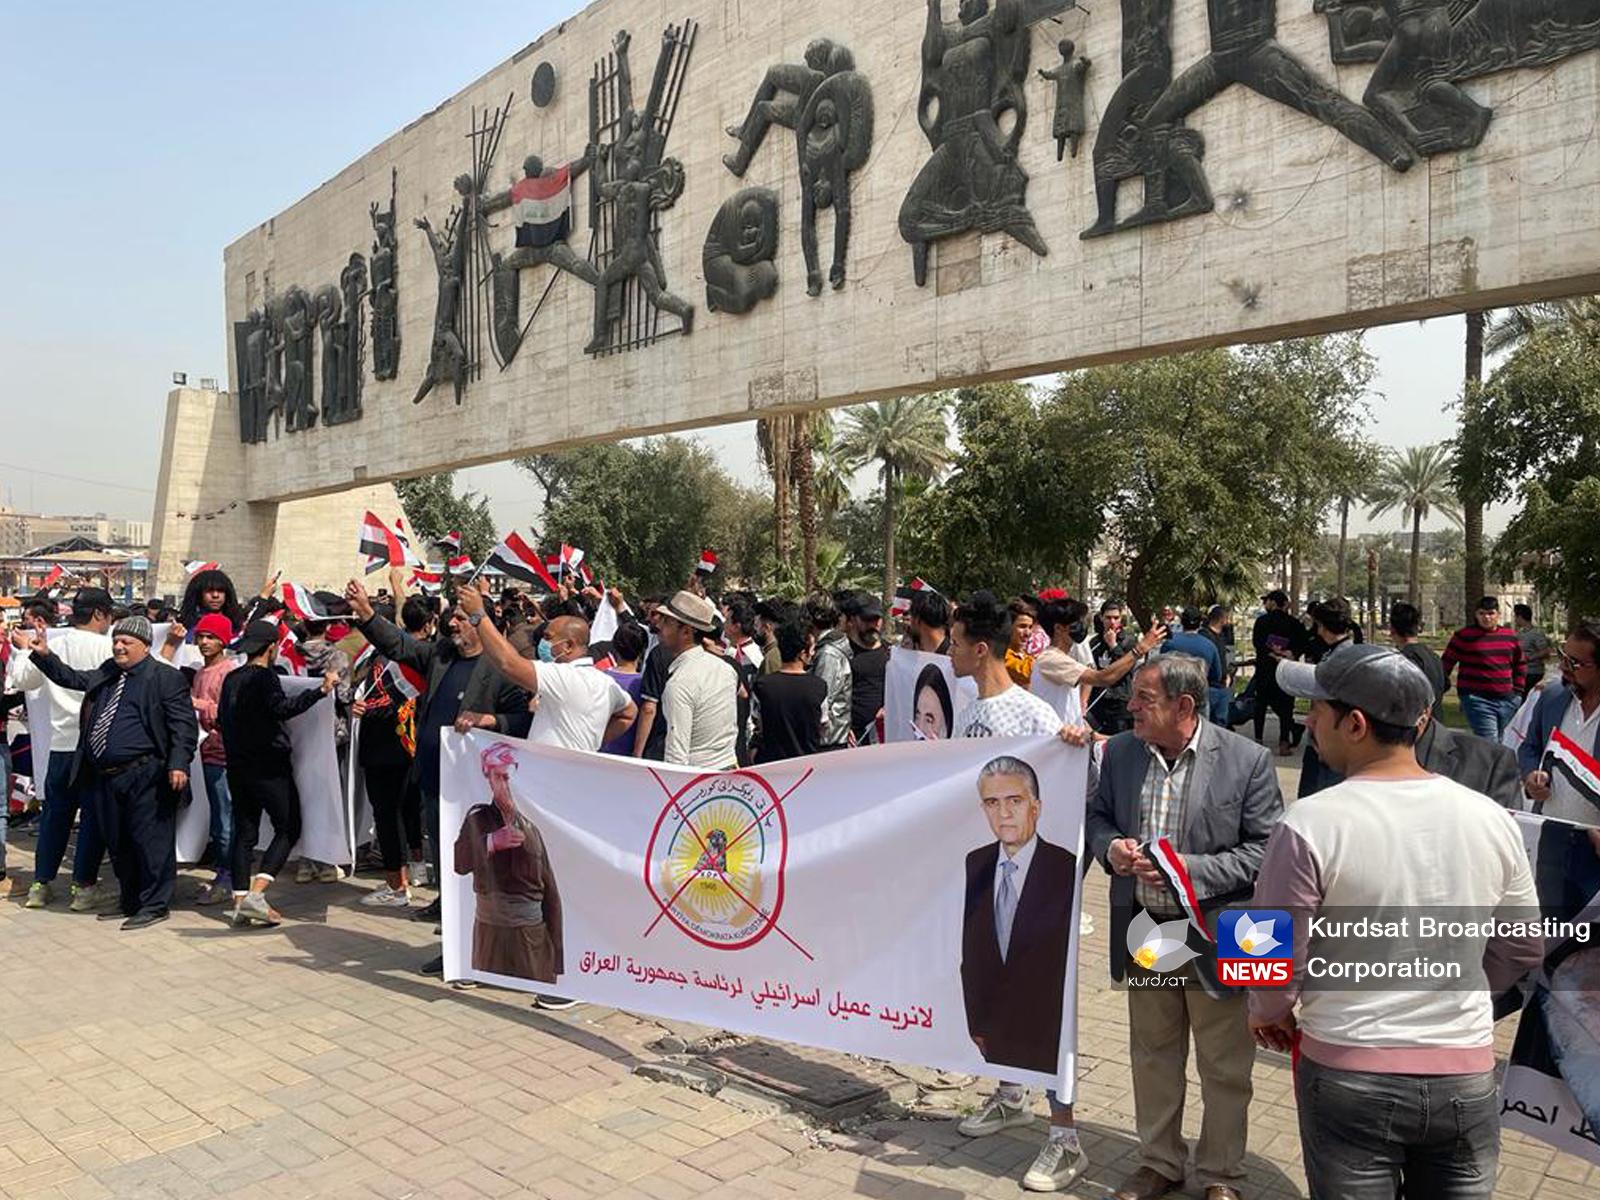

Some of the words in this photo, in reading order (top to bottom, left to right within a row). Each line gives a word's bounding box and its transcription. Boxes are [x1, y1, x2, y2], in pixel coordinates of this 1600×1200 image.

[579, 951, 620, 975] العراق
[626, 957, 688, 989] جمهورية
[694, 970, 743, 998] لرئاسة
[751, 981, 820, 1010] اسرائيلي
[828, 991, 871, 1020] عميل
[879, 1005, 933, 1030] لانريد
[1500, 1099, 1558, 1125] احمر
